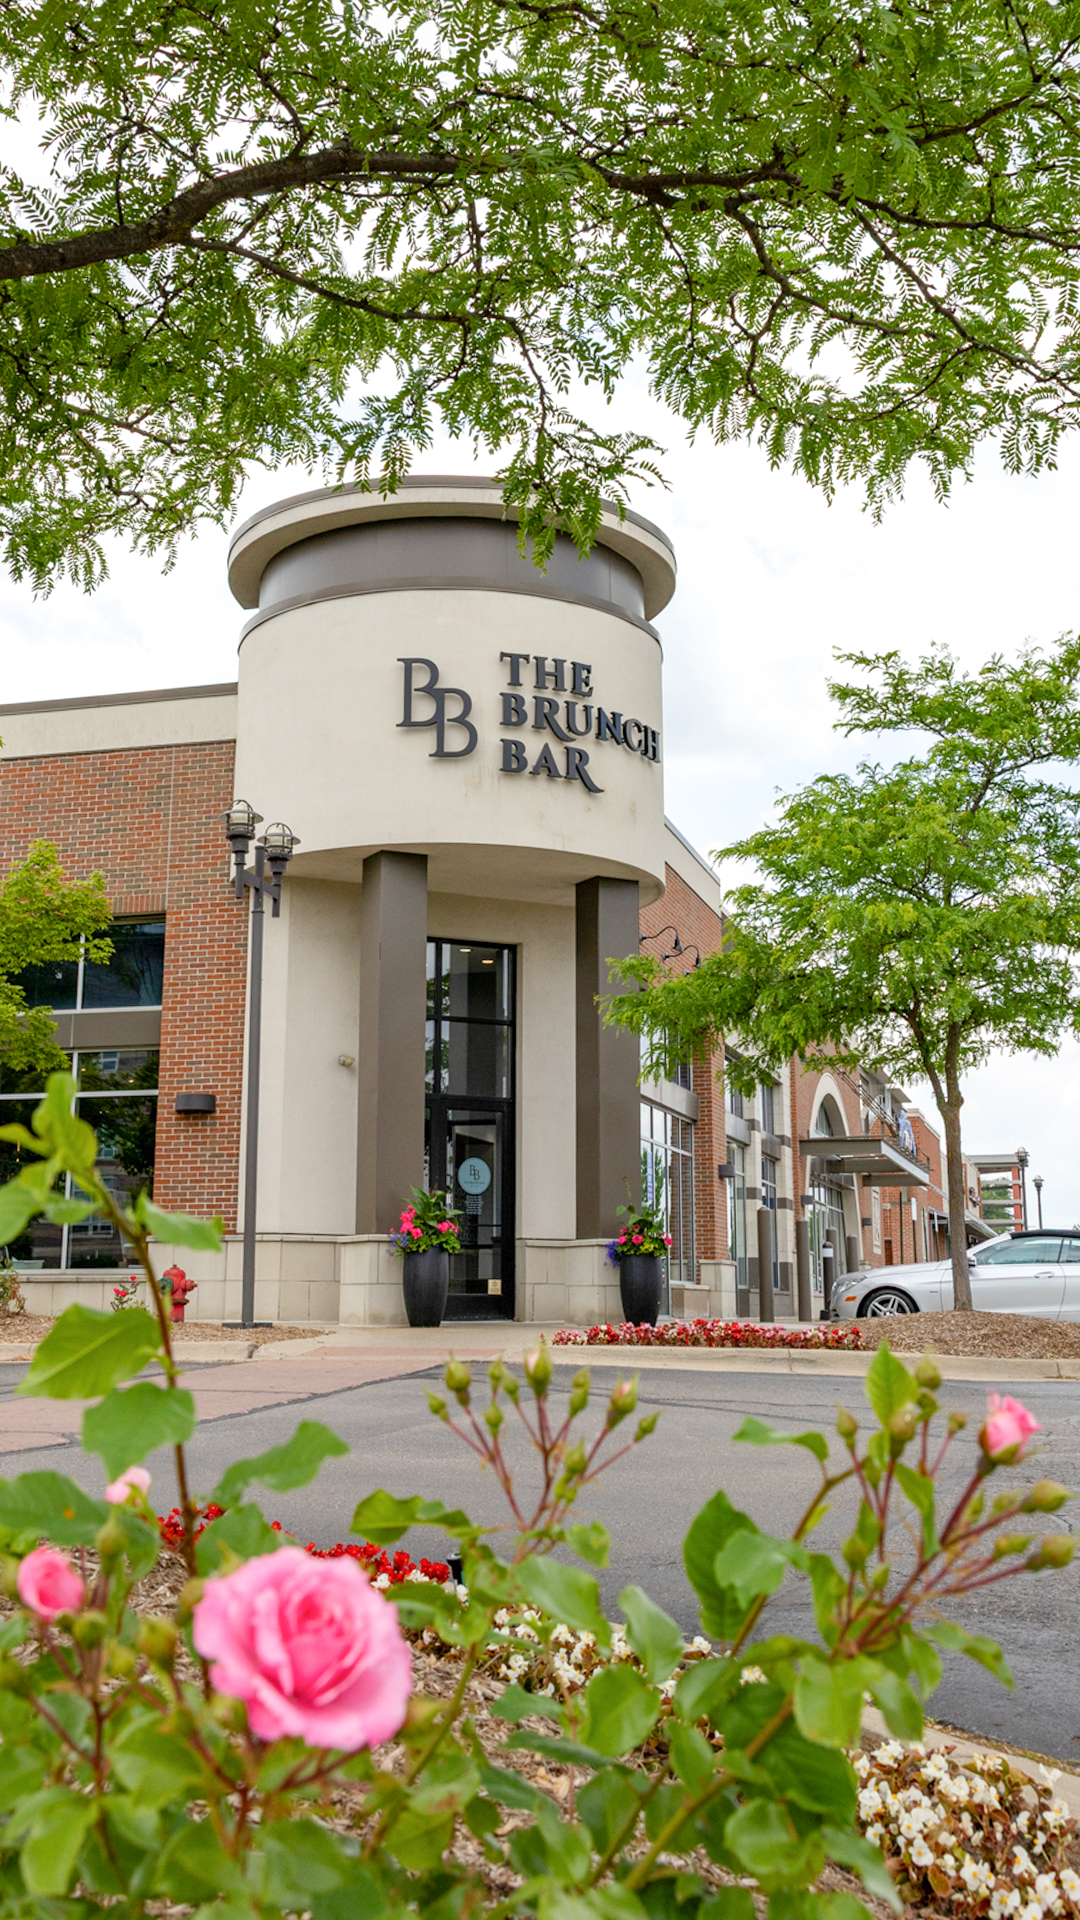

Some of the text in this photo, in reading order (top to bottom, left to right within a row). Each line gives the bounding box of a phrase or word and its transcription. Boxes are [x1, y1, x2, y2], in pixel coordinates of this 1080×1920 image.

[499, 651, 593, 697] THE
[396, 658, 478, 758] BB
[499, 692, 661, 763] BRUNCH
[499, 738, 605, 793] BAR
